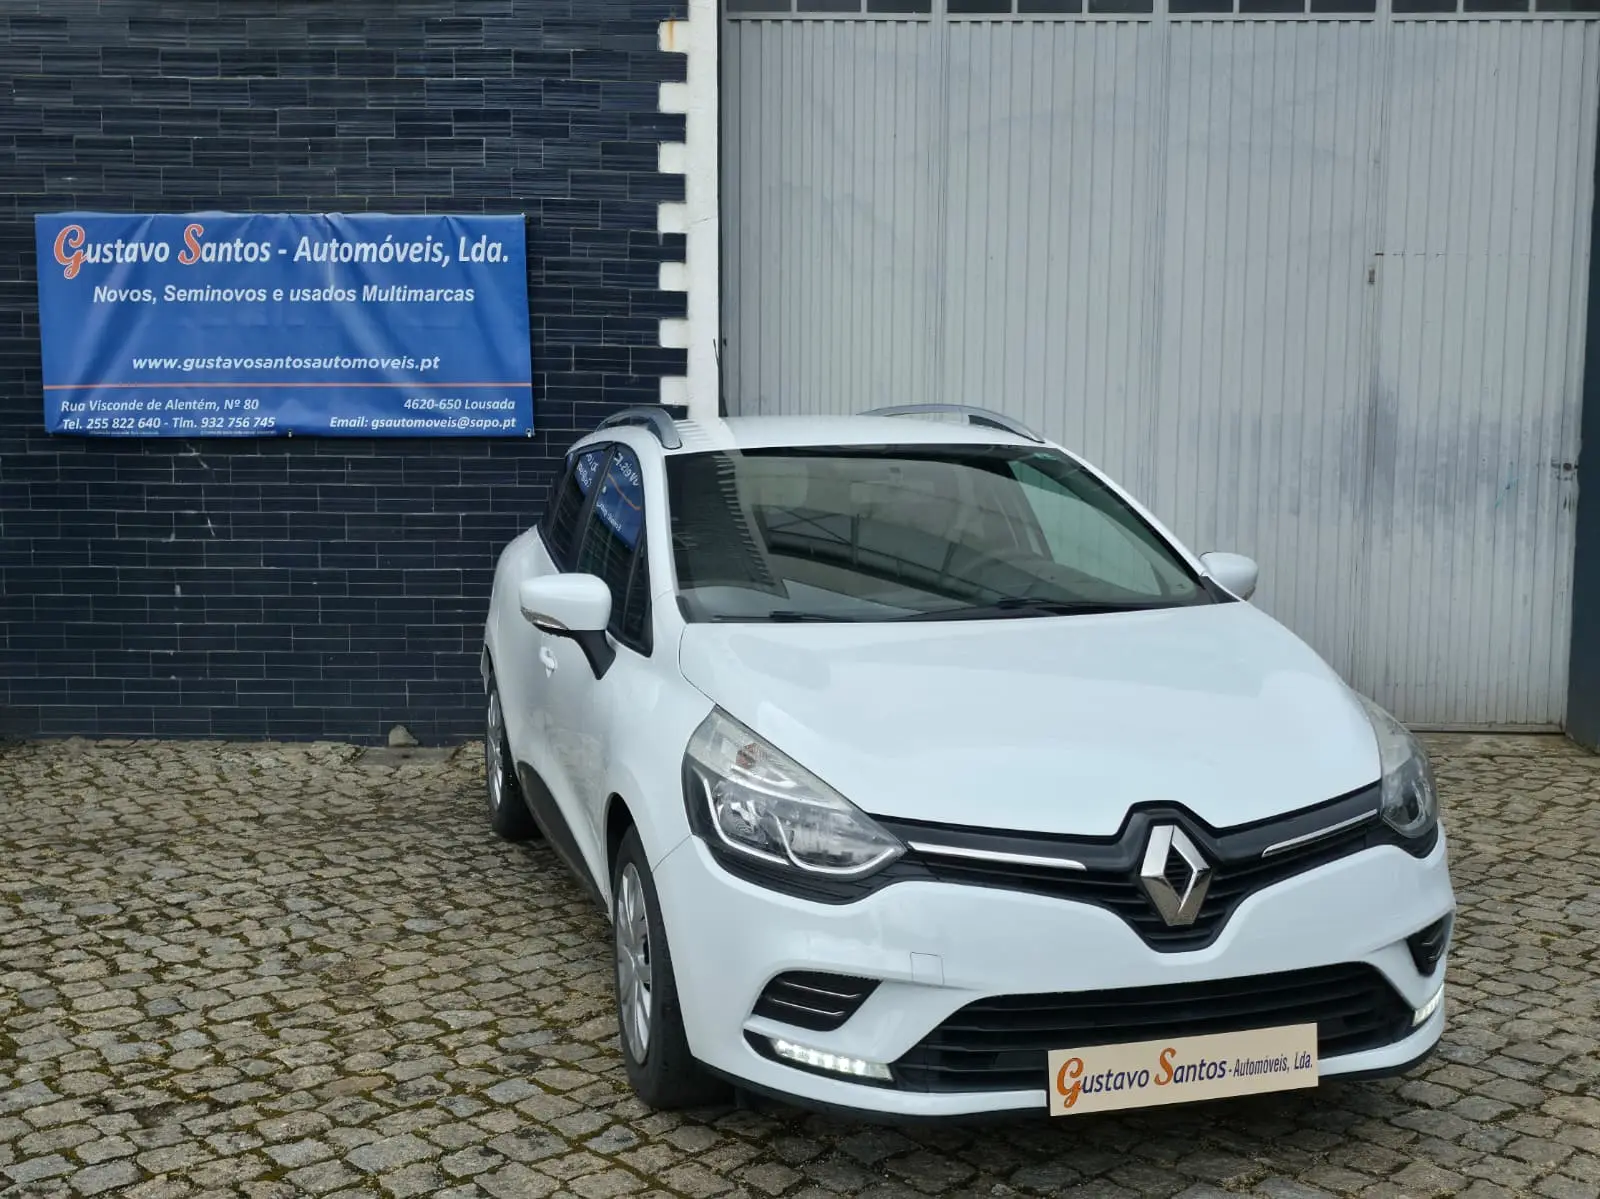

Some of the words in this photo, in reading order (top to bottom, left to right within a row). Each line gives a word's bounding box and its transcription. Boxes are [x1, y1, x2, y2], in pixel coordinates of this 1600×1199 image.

[54, 224, 170, 280] Gustavo
[178, 223, 271, 265] Santos
[293, 234, 450, 267] Automóveis,
[458, 234, 509, 263] Lda.
[93, 286, 157, 304] Novos,
[163, 284, 267, 302] Seminovos
[272, 288, 284, 301] e
[289, 285, 357, 302] usados
[362, 285, 475, 302] Multimarcas
[132, 356, 441, 371] www.gustavosantosautomoveis.pt
[60, 400, 86, 412] Rua
[89, 399, 144, 411] Visconde
[147, 399, 162, 410] de
[165, 398, 220, 412] Alentém,
[224, 399, 240, 410] Nº
[243, 398, 259, 410] 80
[403, 398, 462, 410] 4620-650
[464, 398, 516, 410] Lousada
[62, 418, 83, 430] Tel.
[86, 418, 109, 429] 255
[112, 418, 135, 429] 822
[138, 417, 161, 429] 640
[201, 416, 226, 428] 932
[228, 416, 252, 428] 756
[254, 416, 276, 428] 745
[329, 416, 369, 428] Email:
[371, 416, 516, 430] gsautomoveis@sapo.pt
[1056, 1057, 1150, 1108] Gustavo
[1154, 1047, 1227, 1086] Santos
[1233, 1054, 1290, 1077] Automóveis,
[1294, 1050, 1313, 1070] Lda.
